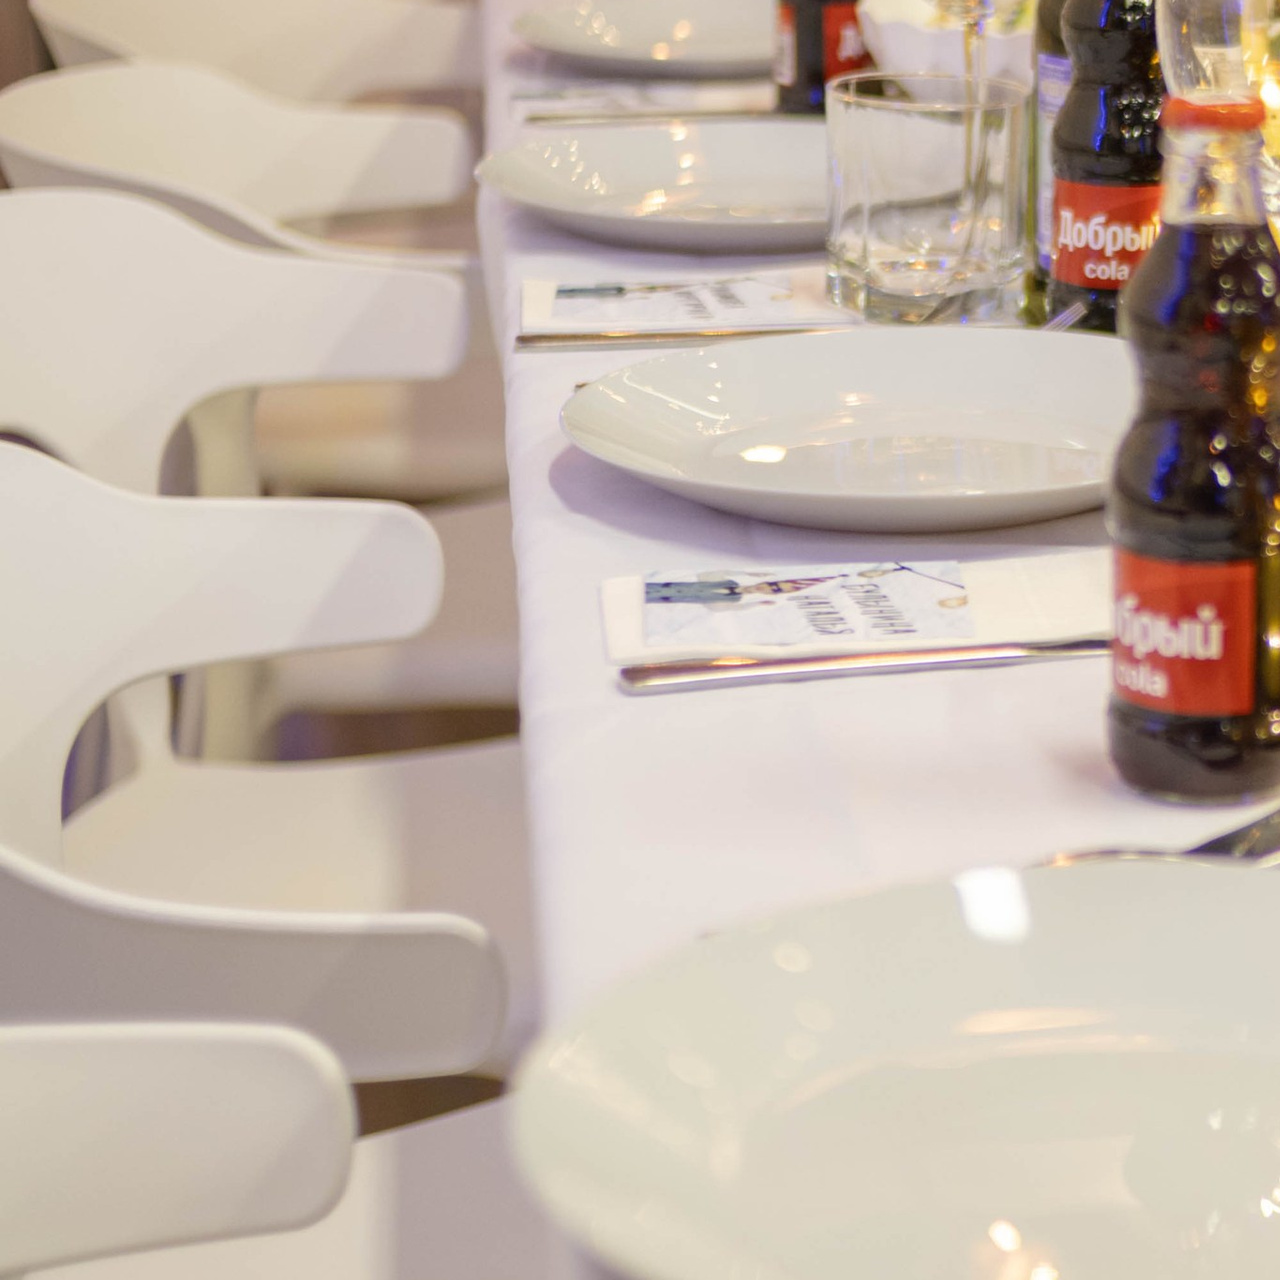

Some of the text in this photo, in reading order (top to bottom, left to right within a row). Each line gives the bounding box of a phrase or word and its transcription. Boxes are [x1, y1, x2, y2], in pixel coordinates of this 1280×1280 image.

[1084, 260, 1129, 281] cola
[787, 594, 855, 636] НАТАЛЬЯ
[1113, 594, 1225, 661] брый
